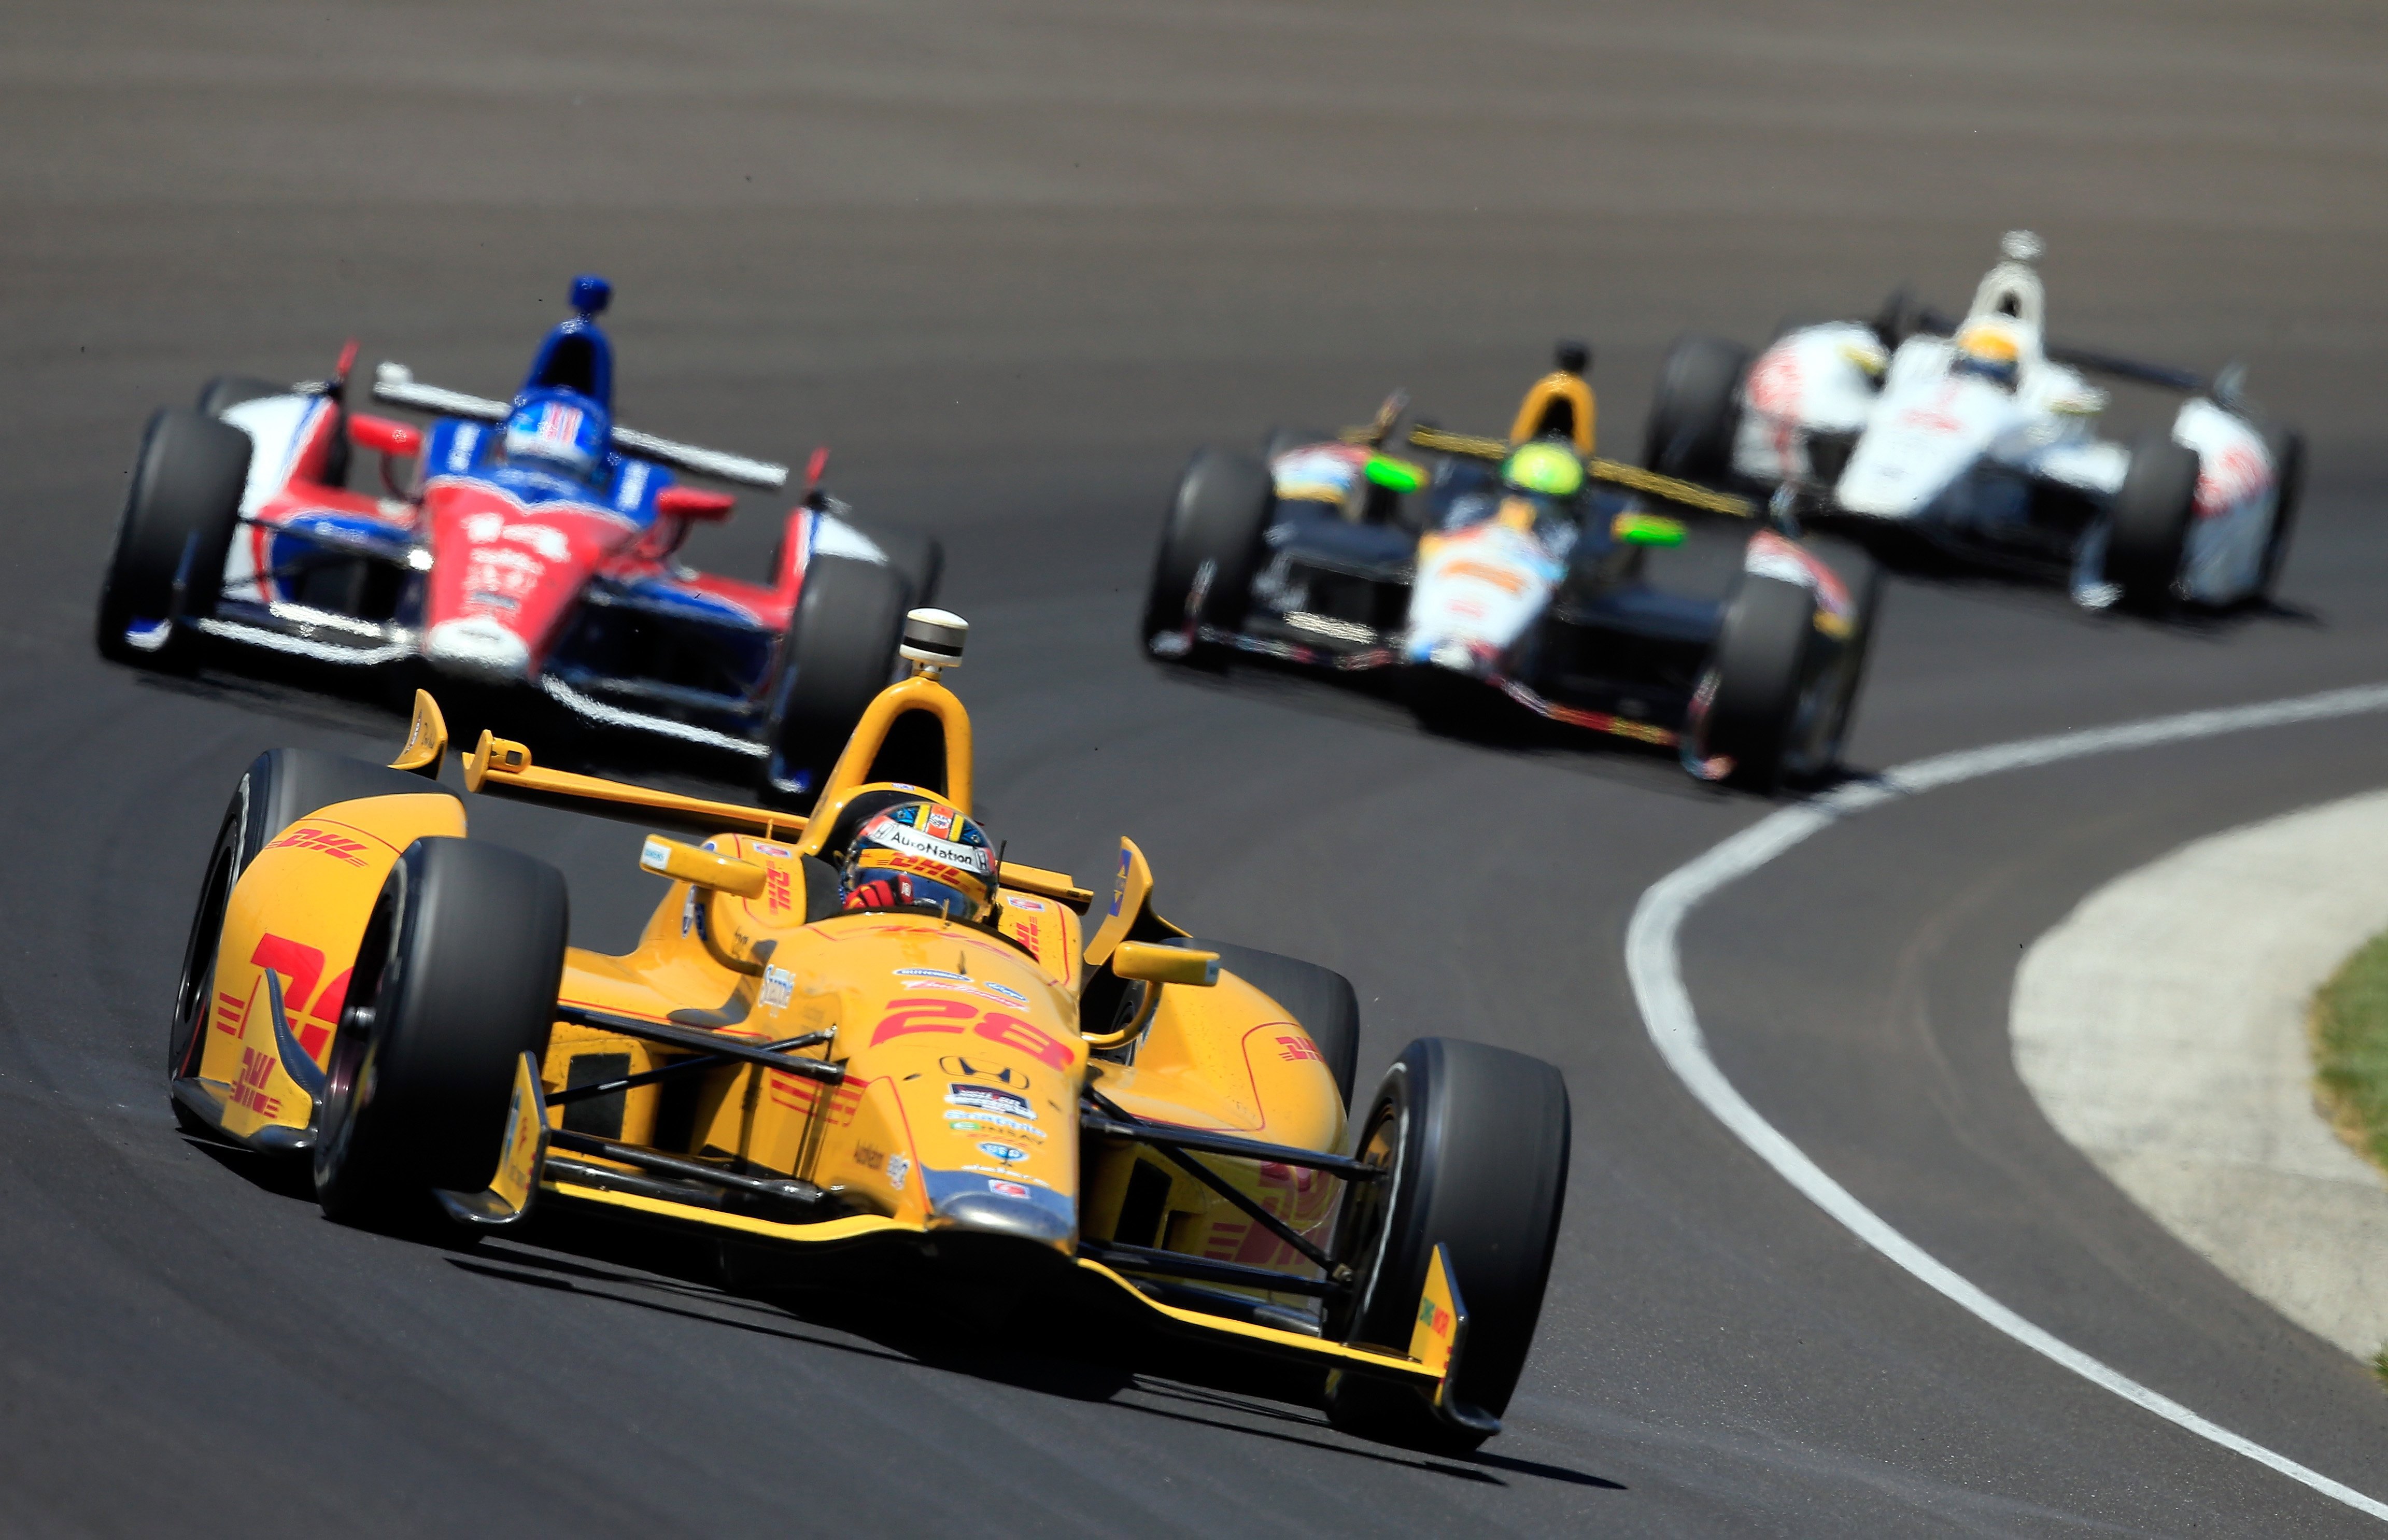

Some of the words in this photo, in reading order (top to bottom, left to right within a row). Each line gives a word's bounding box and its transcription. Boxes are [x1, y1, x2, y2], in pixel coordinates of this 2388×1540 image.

[278, 828, 370, 859] DHL
[889, 852, 960, 885] DHL
[1016, 922, 1040, 964] HL
[869, 998, 1074, 1072] 28
[1276, 1036, 1327, 1063] DH
